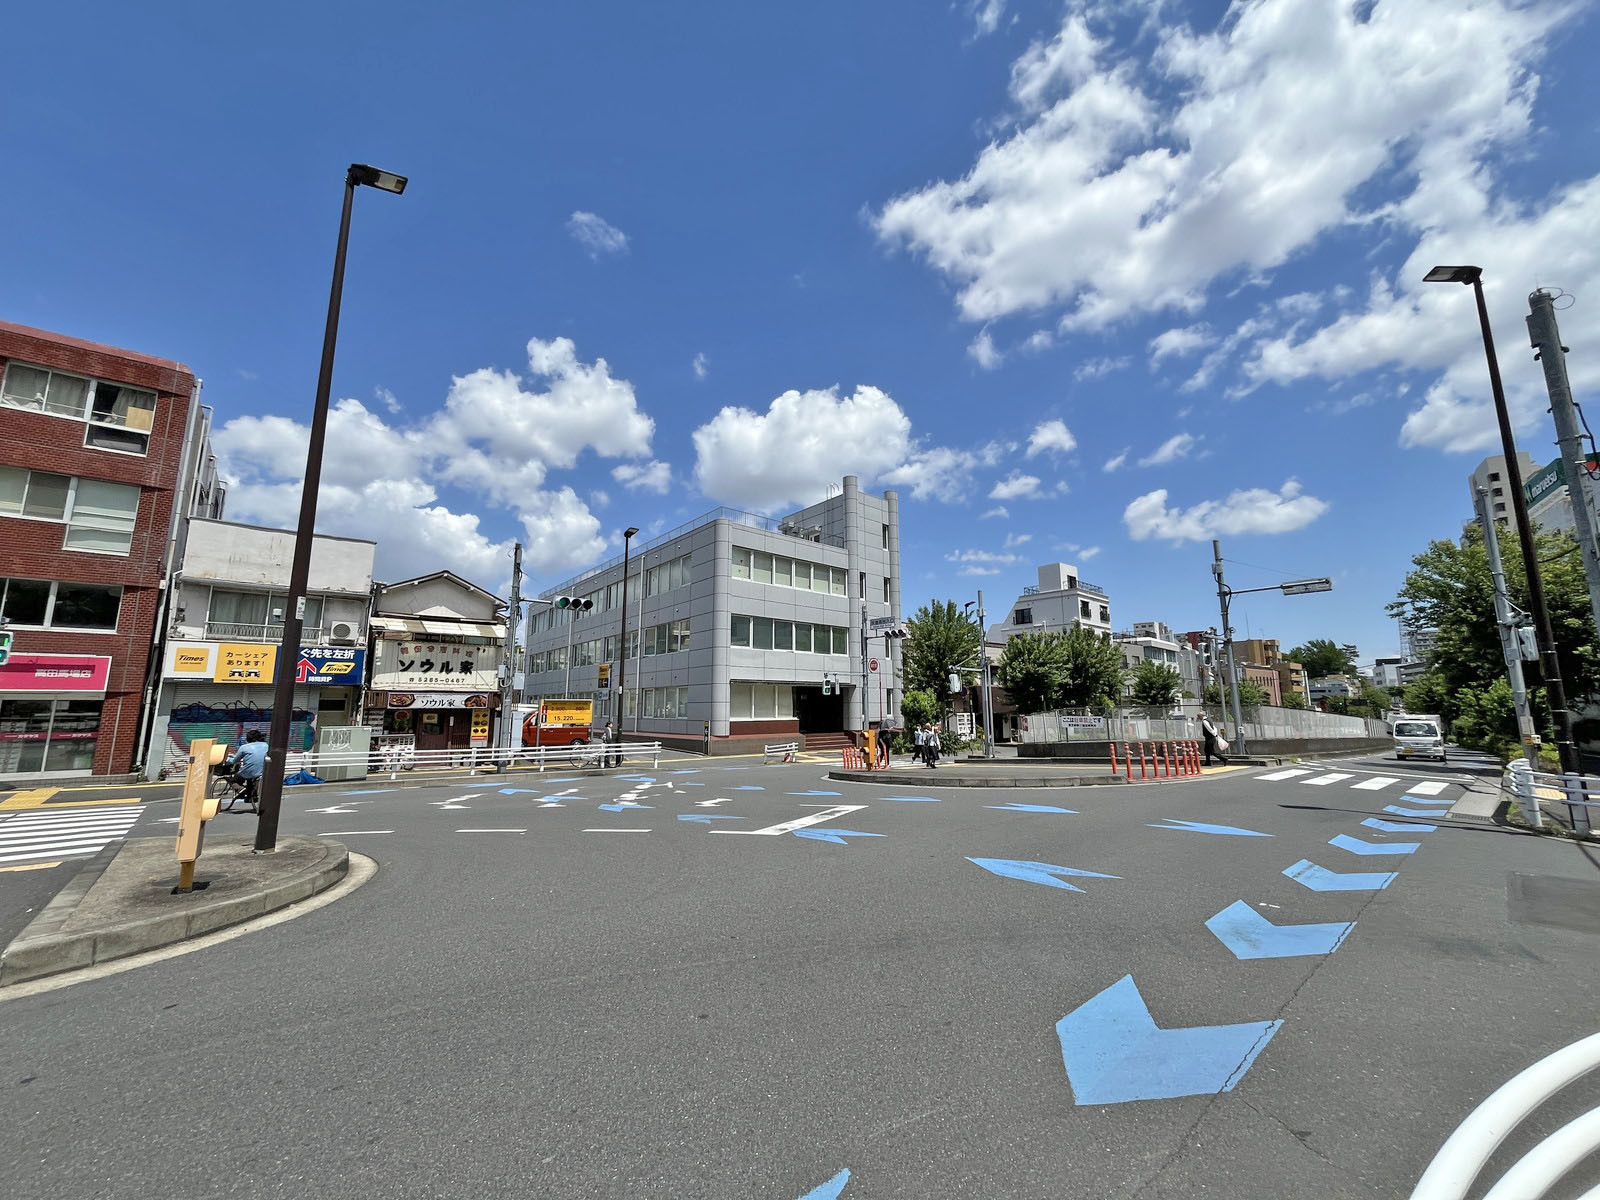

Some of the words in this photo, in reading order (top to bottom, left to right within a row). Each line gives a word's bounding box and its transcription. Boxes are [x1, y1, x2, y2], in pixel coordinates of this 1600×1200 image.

[226, 651, 269, 659] カーシェア
[300, 648, 356, 659] ぐ先を左折
[178, 654, 206, 662] Times
[398, 659, 474, 675] ソウル家
[421, 699, 456, 707] ソウル家
